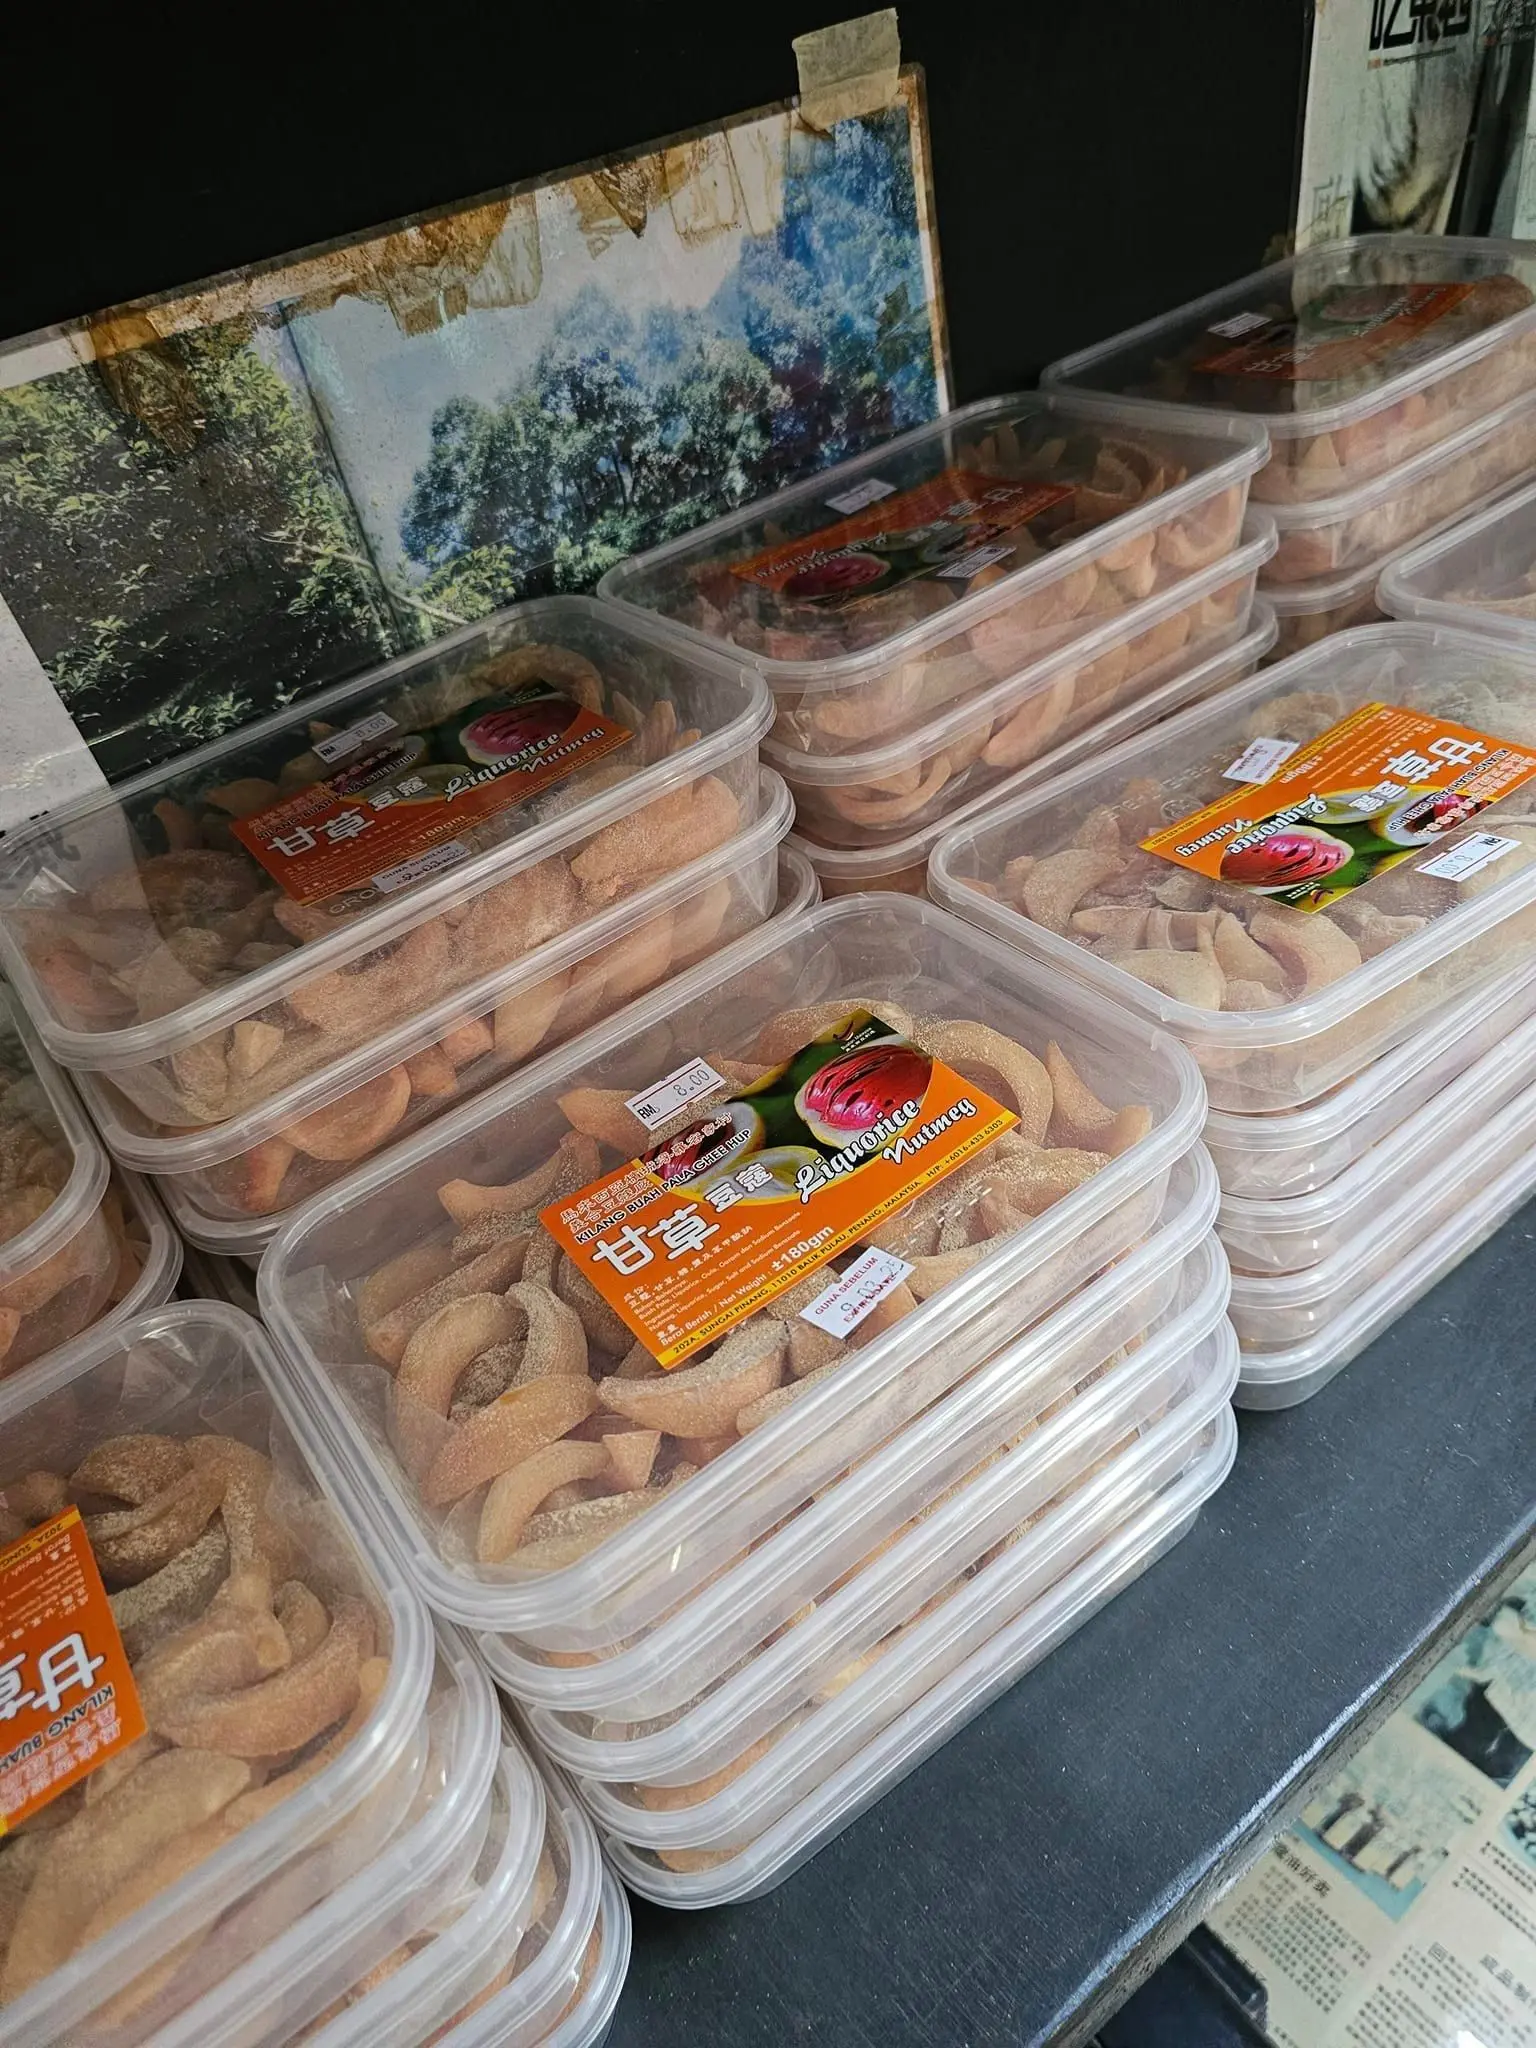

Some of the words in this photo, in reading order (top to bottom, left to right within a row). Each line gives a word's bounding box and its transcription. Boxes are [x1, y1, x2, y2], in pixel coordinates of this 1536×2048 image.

[443, 733, 562, 802] Liquorice
[522, 727, 606, 773] Nutmeg
[1379, 736, 1488, 785] 甘草
[266, 807, 376, 858] 甘草
[1175, 816, 1253, 858] Nutmeg
[1225, 793, 1328, 856] Liquorice
[1431, 854, 1475, 874] 8.00
[636, 1103, 657, 1119] RM
[670, 1068, 712, 1097] 8.00
[794, 1098, 920, 1204] Liquorice
[882, 1097, 977, 1165] Nutmeg
[573, 1206, 629, 1246] KILANG
[623, 1185, 663, 1215] BUAH
[658, 1166, 695, 1193] PALA
[688, 1143, 730, 1173] GHEE
[723, 1126, 755, 1150] HUP
[592, 1203, 721, 1276] 甘草
[704, 1163, 774, 1213] 豆蔻
[672, 1336, 699, 1353] 202A,
[699, 1310, 734, 1336] SUNGAI
[733, 1288, 771, 1312] PINANG,
[771, 1268, 797, 1287] 11010
[796, 1253, 820, 1270] BALIK
[819, 1233, 849, 1254] PULAU,
[847, 1209, 884, 1234] PENANG,
[926, 1164, 943, 1177] H/P:
[944, 1133, 984, 1163] +6016-433
[983, 1119, 1003, 1135] 6303
[660, 1327, 684, 1345] Berat
[718, 1293, 736, 1307] Net
[735, 1273, 766, 1295] Weight
[772, 1226, 833, 1270] ±180gm
[811, 1290, 843, 1316] GUNA
[831, 1256, 884, 1294] SEBELUM
[49, 1685, 113, 1738] KILANG
